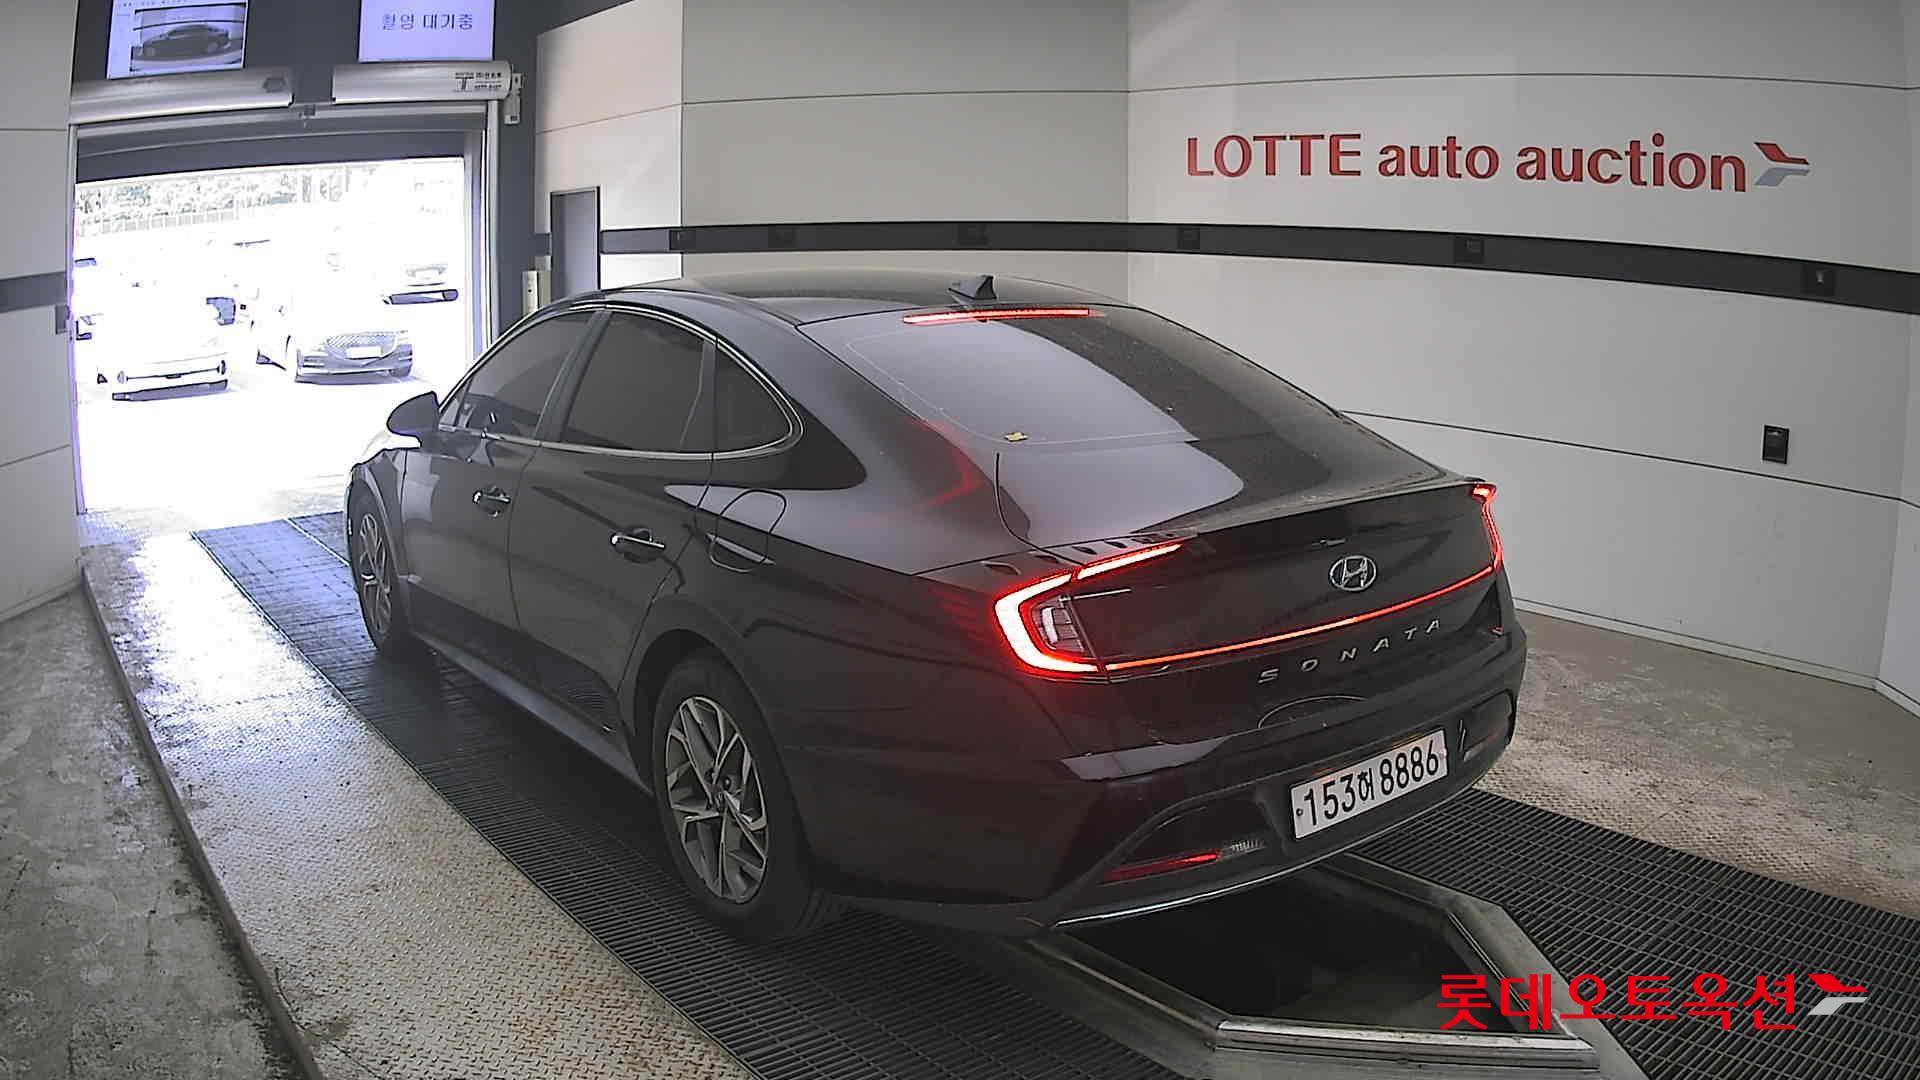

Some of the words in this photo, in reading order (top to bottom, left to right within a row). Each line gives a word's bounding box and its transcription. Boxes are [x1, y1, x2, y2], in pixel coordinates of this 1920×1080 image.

[423, 13, 473, 31] 대기중
[1187, 134, 1361, 177] LOTTE
[1378, 136, 1499, 180] auto
[1516, 134, 1747, 192] auction
[1257, 619, 1441, 684] SONATA
